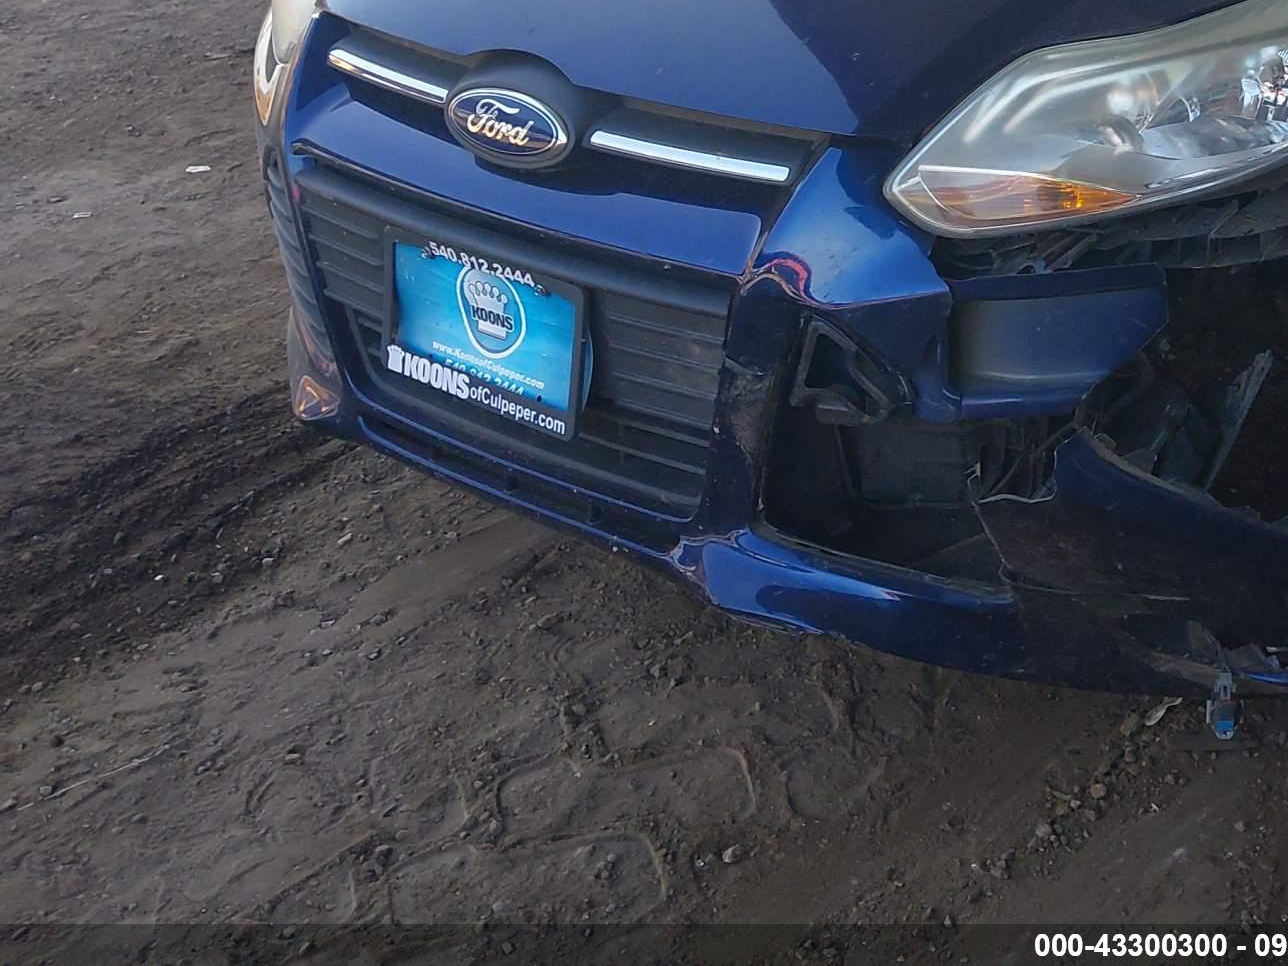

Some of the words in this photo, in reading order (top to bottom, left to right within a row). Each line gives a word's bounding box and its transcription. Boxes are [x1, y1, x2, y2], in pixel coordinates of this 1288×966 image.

[467, 99, 535, 146] Ford
[428, 241, 536, 288] 540.812.2444
[471, 304, 514, 332] KOONS
